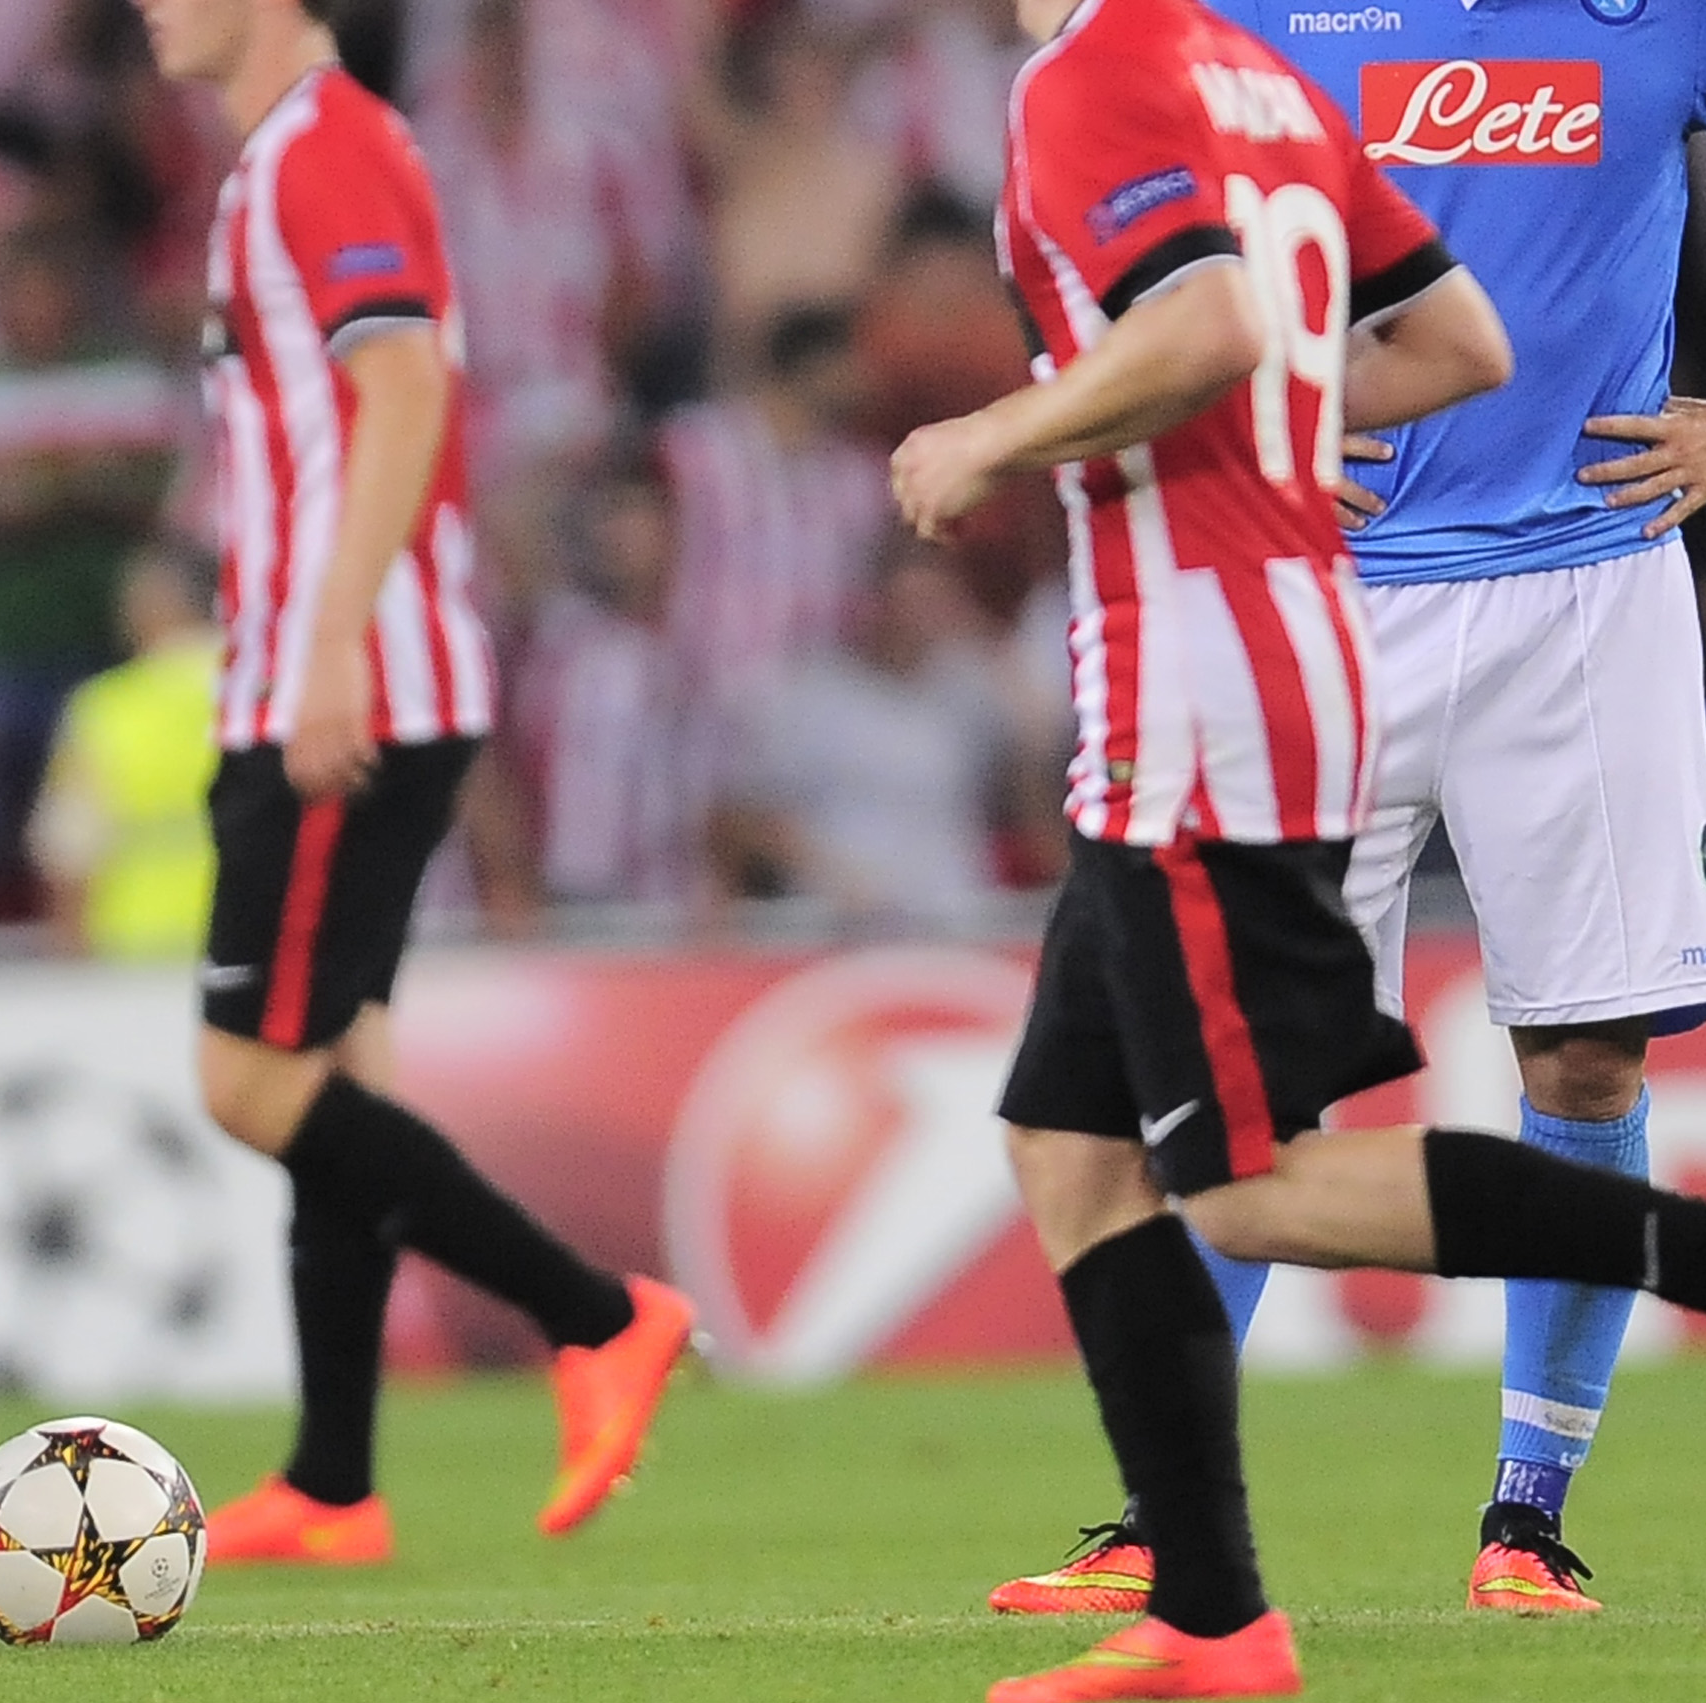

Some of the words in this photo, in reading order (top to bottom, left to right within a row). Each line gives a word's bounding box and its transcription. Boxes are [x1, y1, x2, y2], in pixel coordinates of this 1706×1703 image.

[1289, 6, 1402, 34] macron
[1363, 59, 1601, 164] Lete
[1223, 173, 1351, 492] 19
